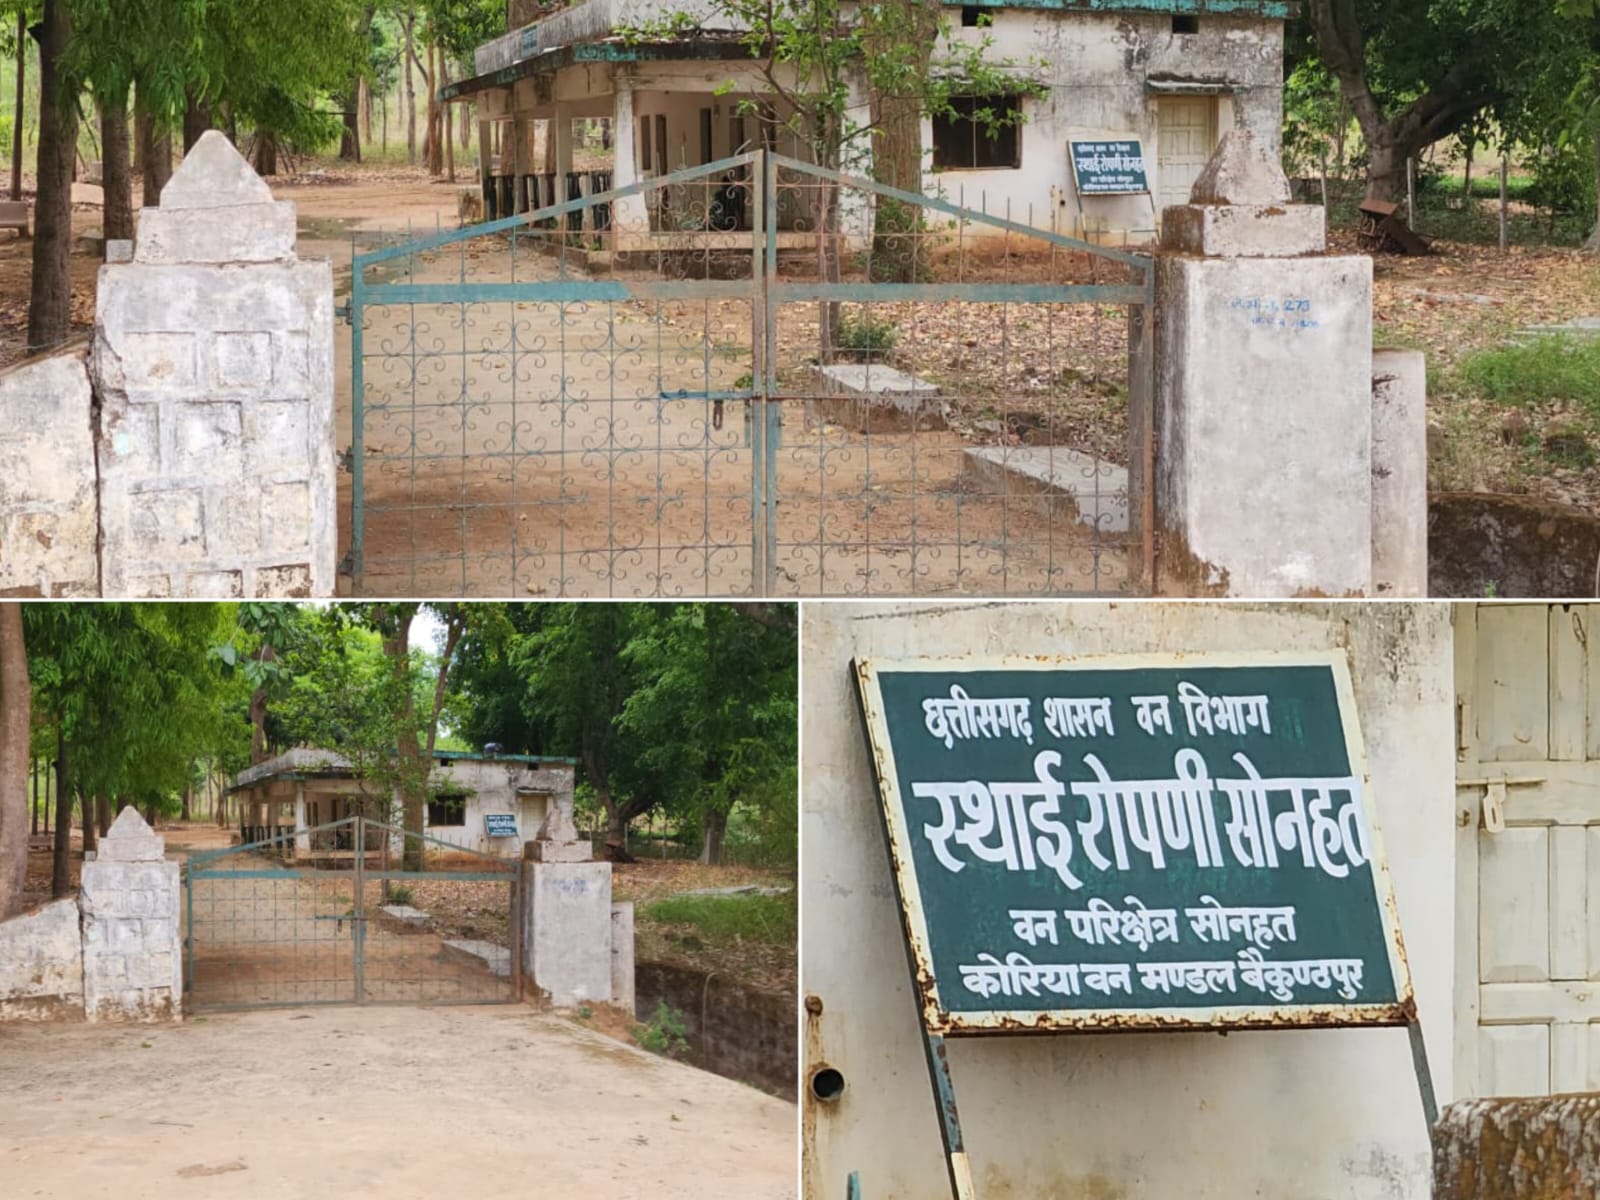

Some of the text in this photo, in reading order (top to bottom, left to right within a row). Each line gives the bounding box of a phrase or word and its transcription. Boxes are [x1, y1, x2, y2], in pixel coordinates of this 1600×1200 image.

[1043, 697, 1114, 737] शासन
[1131, 695, 1173, 736] वन
[1178, 681, 1271, 736] विभाग
[1070, 748, 1224, 871] रोपणी
[1216, 752, 1371, 878] सोनहत
[1009, 895, 1296, 952] वन परिक्षेत्र सोनहत
[958, 947, 1363, 1001] कोरिया वन मण्डल बैकुण्ठपुर
